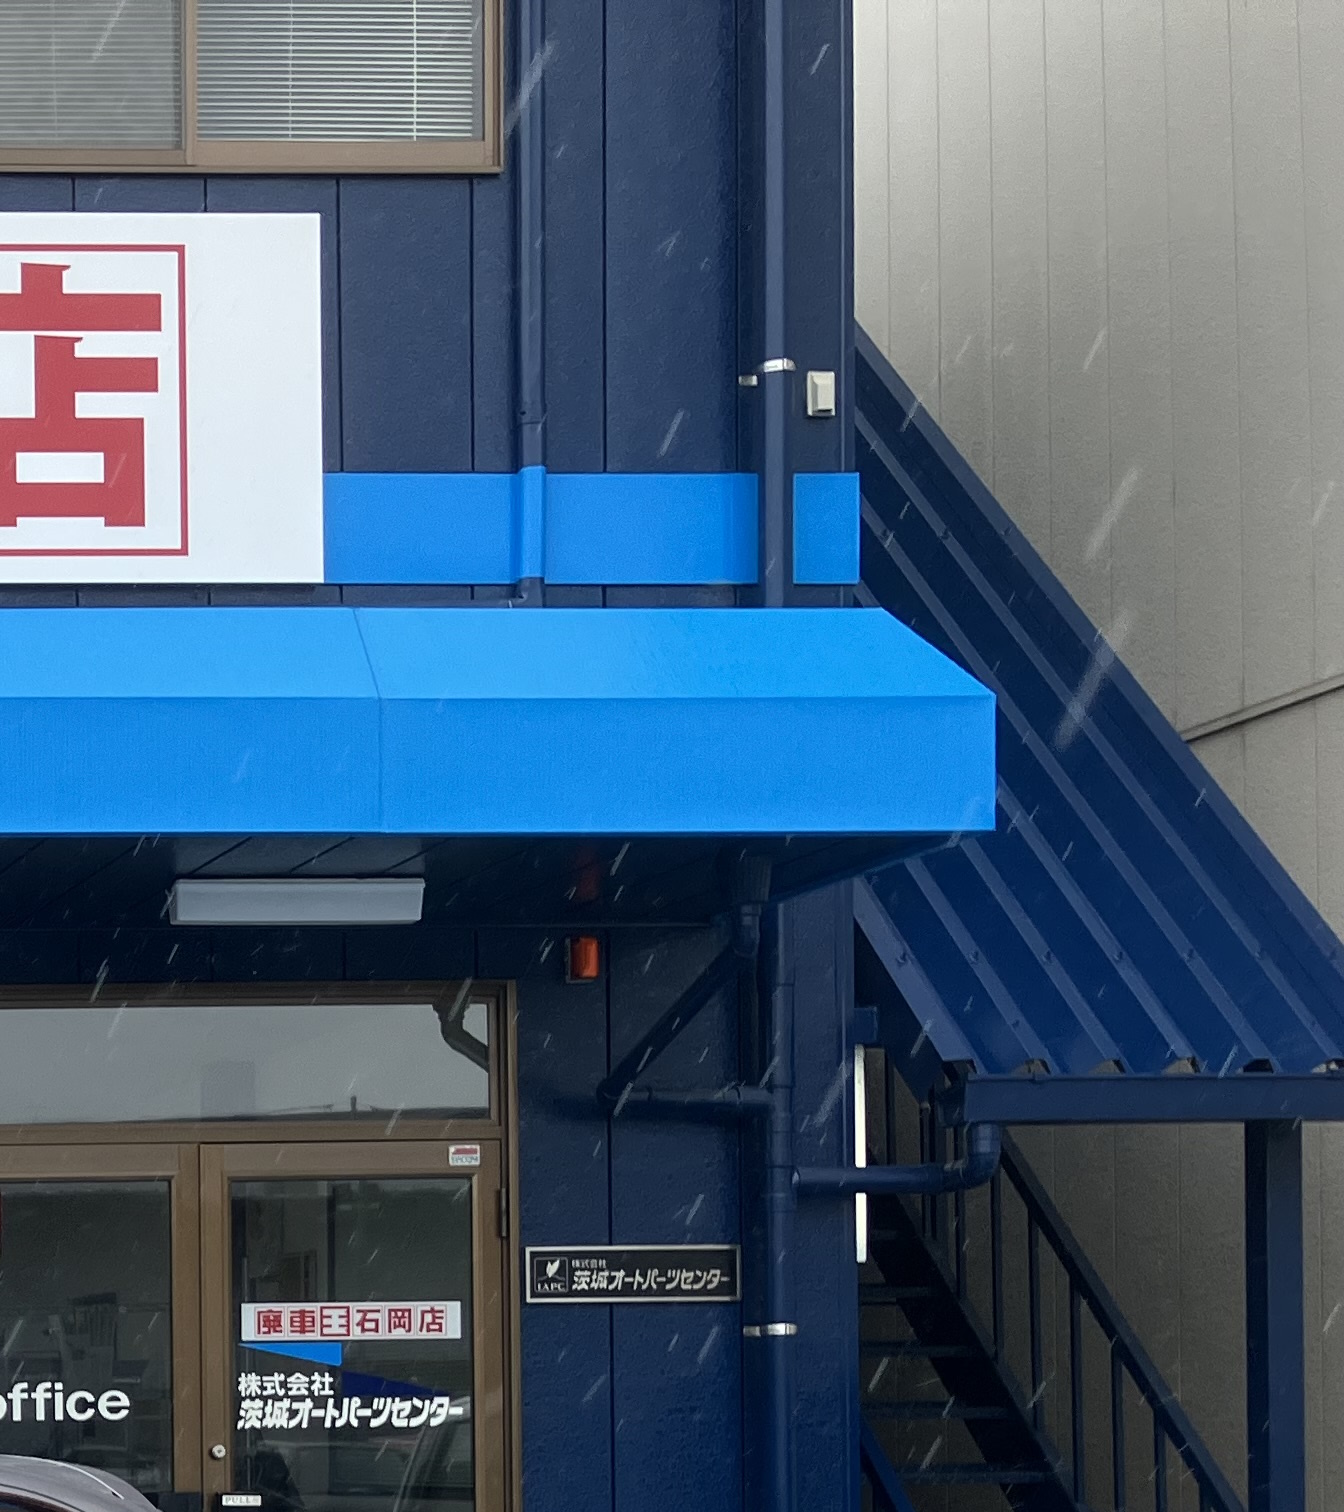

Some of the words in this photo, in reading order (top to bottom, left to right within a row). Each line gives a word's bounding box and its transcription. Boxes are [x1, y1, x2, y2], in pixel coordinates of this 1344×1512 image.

[572, 1268, 730, 1291] 茨城オートパーツセンター
[256, 1306, 445, 1337] 廃車王石岡店
[237, 1372, 334, 1397] 株式会社
[236, 1396, 464, 1430] 茨城オートパーツセンター
